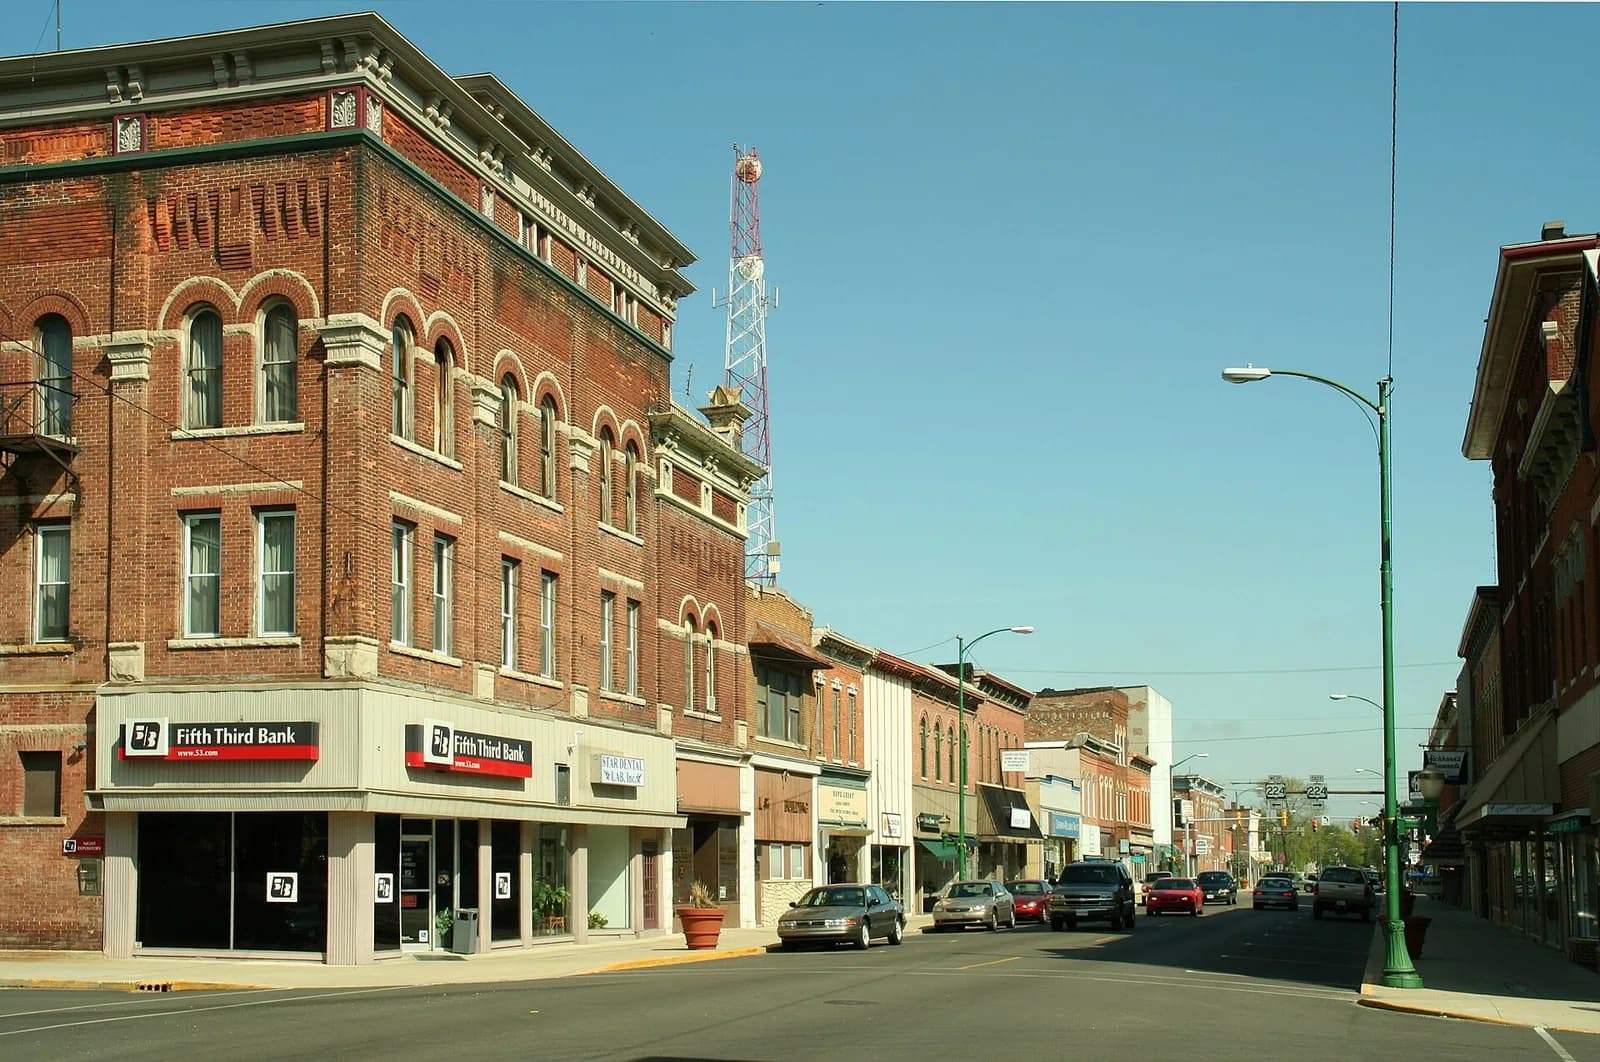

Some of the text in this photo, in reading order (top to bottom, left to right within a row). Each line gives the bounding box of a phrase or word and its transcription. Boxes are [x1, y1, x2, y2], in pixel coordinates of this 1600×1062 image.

[177, 727, 296, 745] Fifth Third Bank
[454, 735, 525, 762] Fifth Third Bank
[454, 760, 480, 769] www.53.com
[602, 756, 643, 771] STAR DENTAL
[1267, 786, 1286, 796] 224
[1308, 786, 1327, 796] 224
